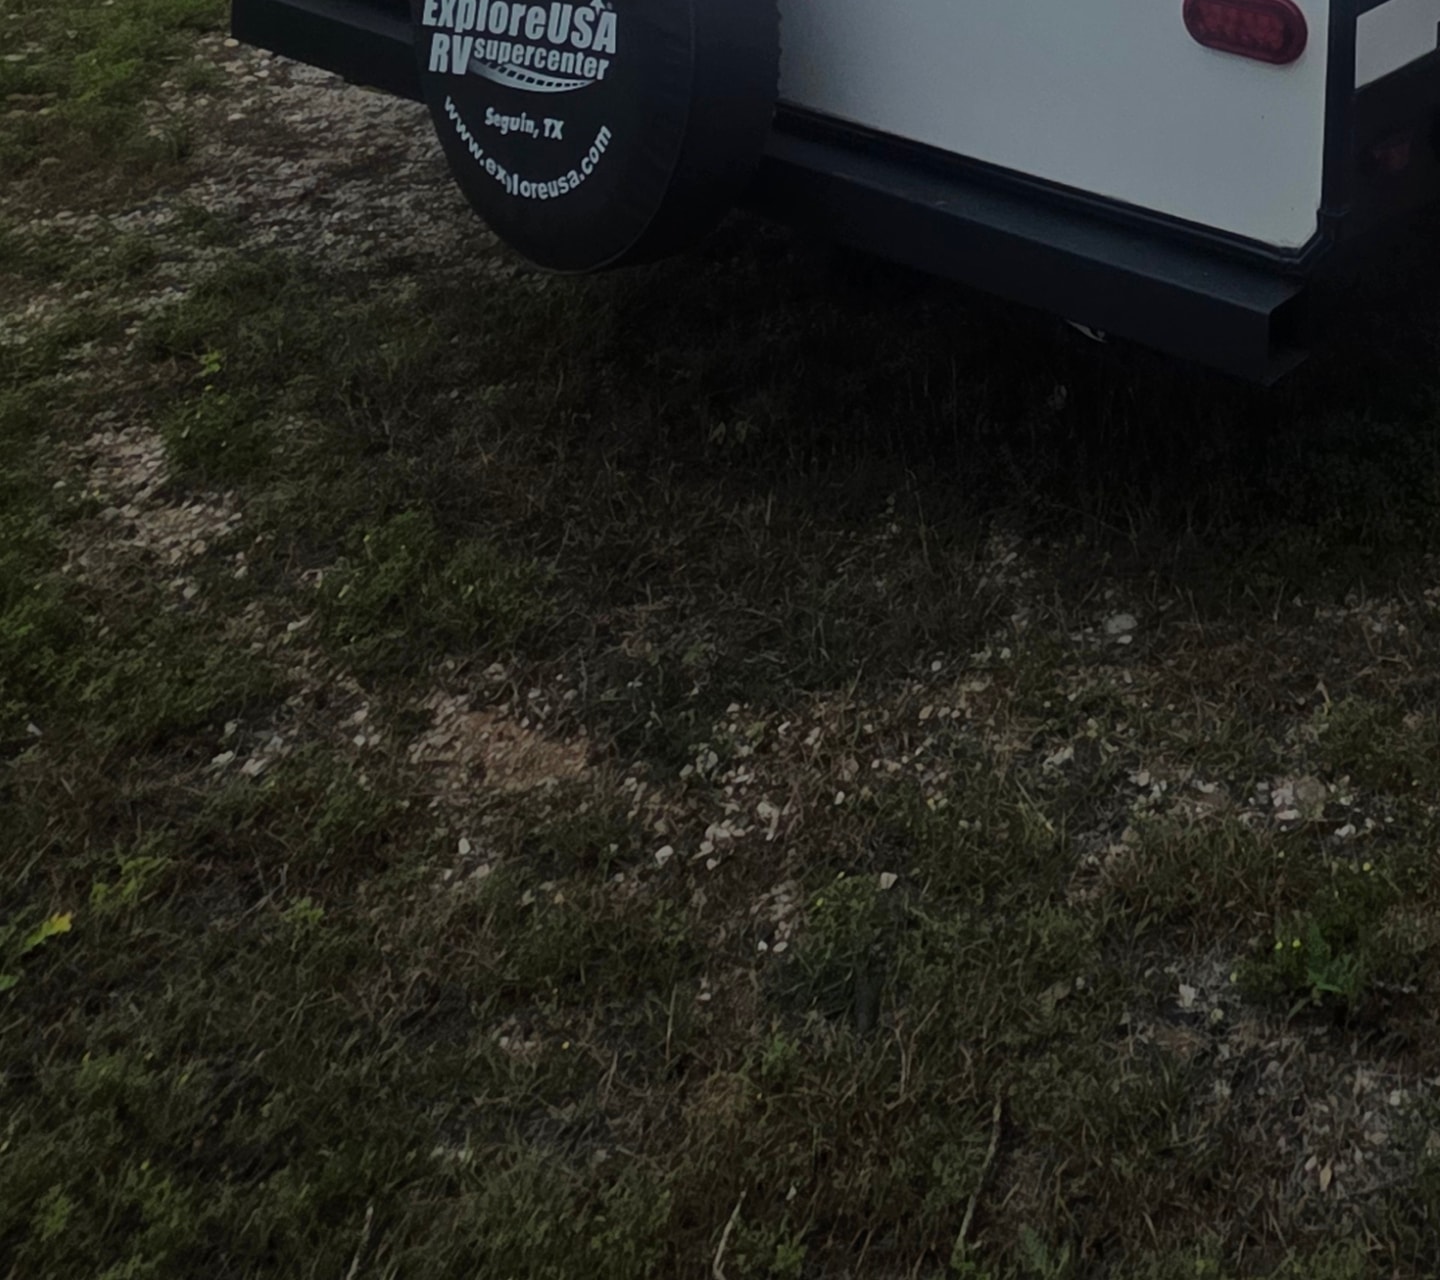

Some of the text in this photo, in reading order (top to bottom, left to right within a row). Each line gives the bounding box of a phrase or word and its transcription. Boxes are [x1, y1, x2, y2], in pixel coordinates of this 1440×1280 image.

[428, 32, 609, 80] RV supercenter
[484, 107, 564, 140] Seguin, TX
